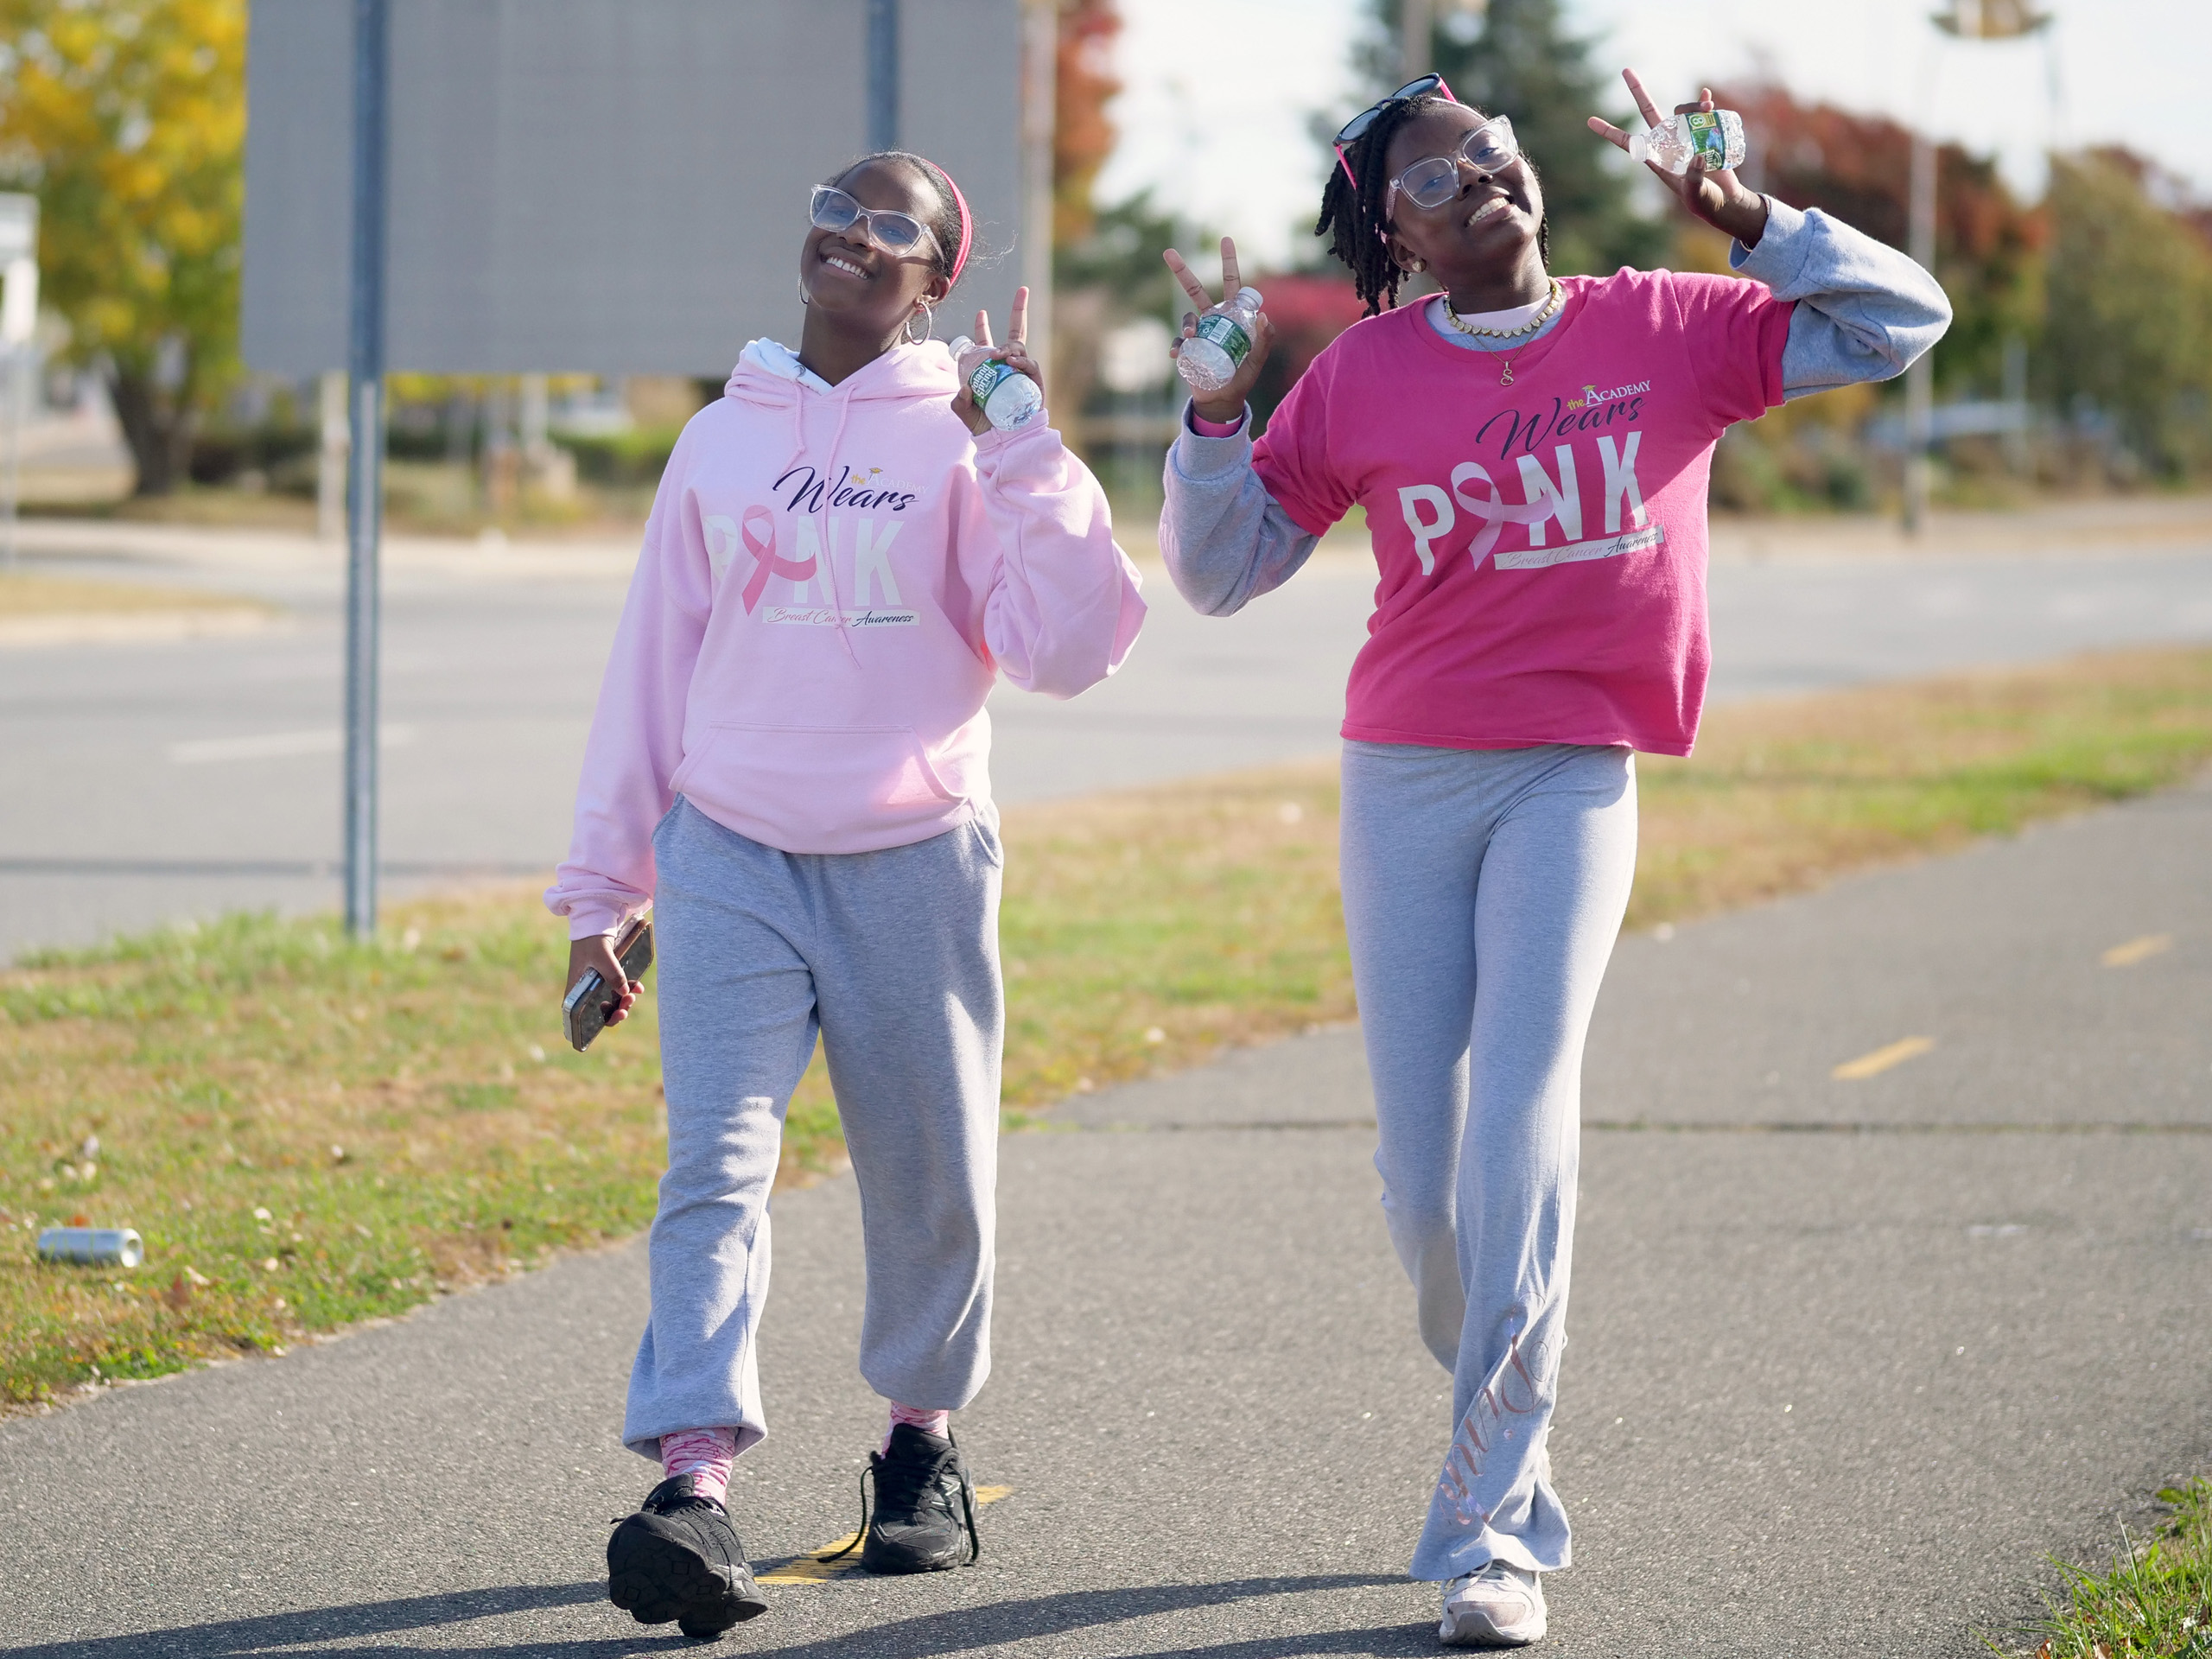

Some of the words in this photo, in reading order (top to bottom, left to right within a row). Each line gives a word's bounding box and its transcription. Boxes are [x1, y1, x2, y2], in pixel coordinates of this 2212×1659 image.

[976, 367, 998, 399] Spring
[1567, 398, 1585, 410] the
[1585, 380, 1651, 407] ACADEMY
[1475, 397, 1645, 461] Wears
[772, 466, 920, 513] Wears
[851, 474, 867, 485] the
[1501, 548, 1552, 569] Breast
[1555, 545, 1602, 563] Cancer
[1604, 531, 1658, 557] Awareness
[767, 607, 814, 623] Breast
[852, 611, 914, 627] Awareness
[1438, 1293, 1550, 1526] Pink
